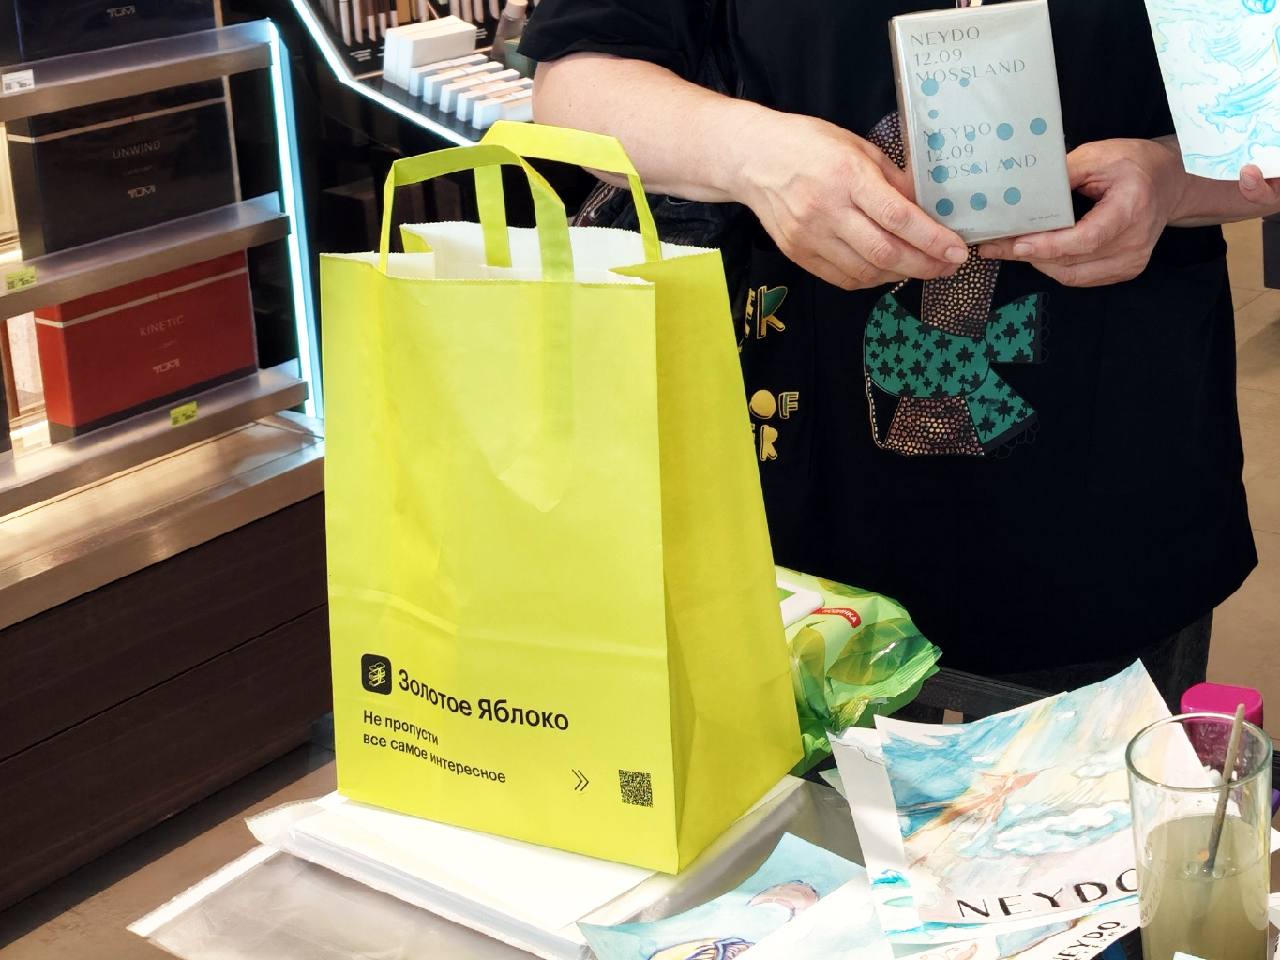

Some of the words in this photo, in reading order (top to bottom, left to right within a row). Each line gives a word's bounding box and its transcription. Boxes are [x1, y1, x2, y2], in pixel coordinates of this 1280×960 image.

[910, 26, 980, 47] NEYDO
[913, 48, 962, 67] 12.09
[915, 59, 1026, 86] MOSSLAND
[923, 122, 991, 143] NEYDO
[112, 140, 160, 159] UNWIND
[926, 144, 974, 163] 12.09
[927, 154, 1037, 182] MOSSLAND
[140, 314, 184, 337] KINETIC
[398, 668, 473, 717] Золотое
[477, 698, 570, 731] Яблоко
[363, 710, 382, 727] Не
[384, 717, 439, 746] пропусти
[363, 732, 387, 748] все
[390, 738, 428, 760] самое
[430, 754, 506, 784] интересное
[1052, 921, 1121, 960] EYDO
